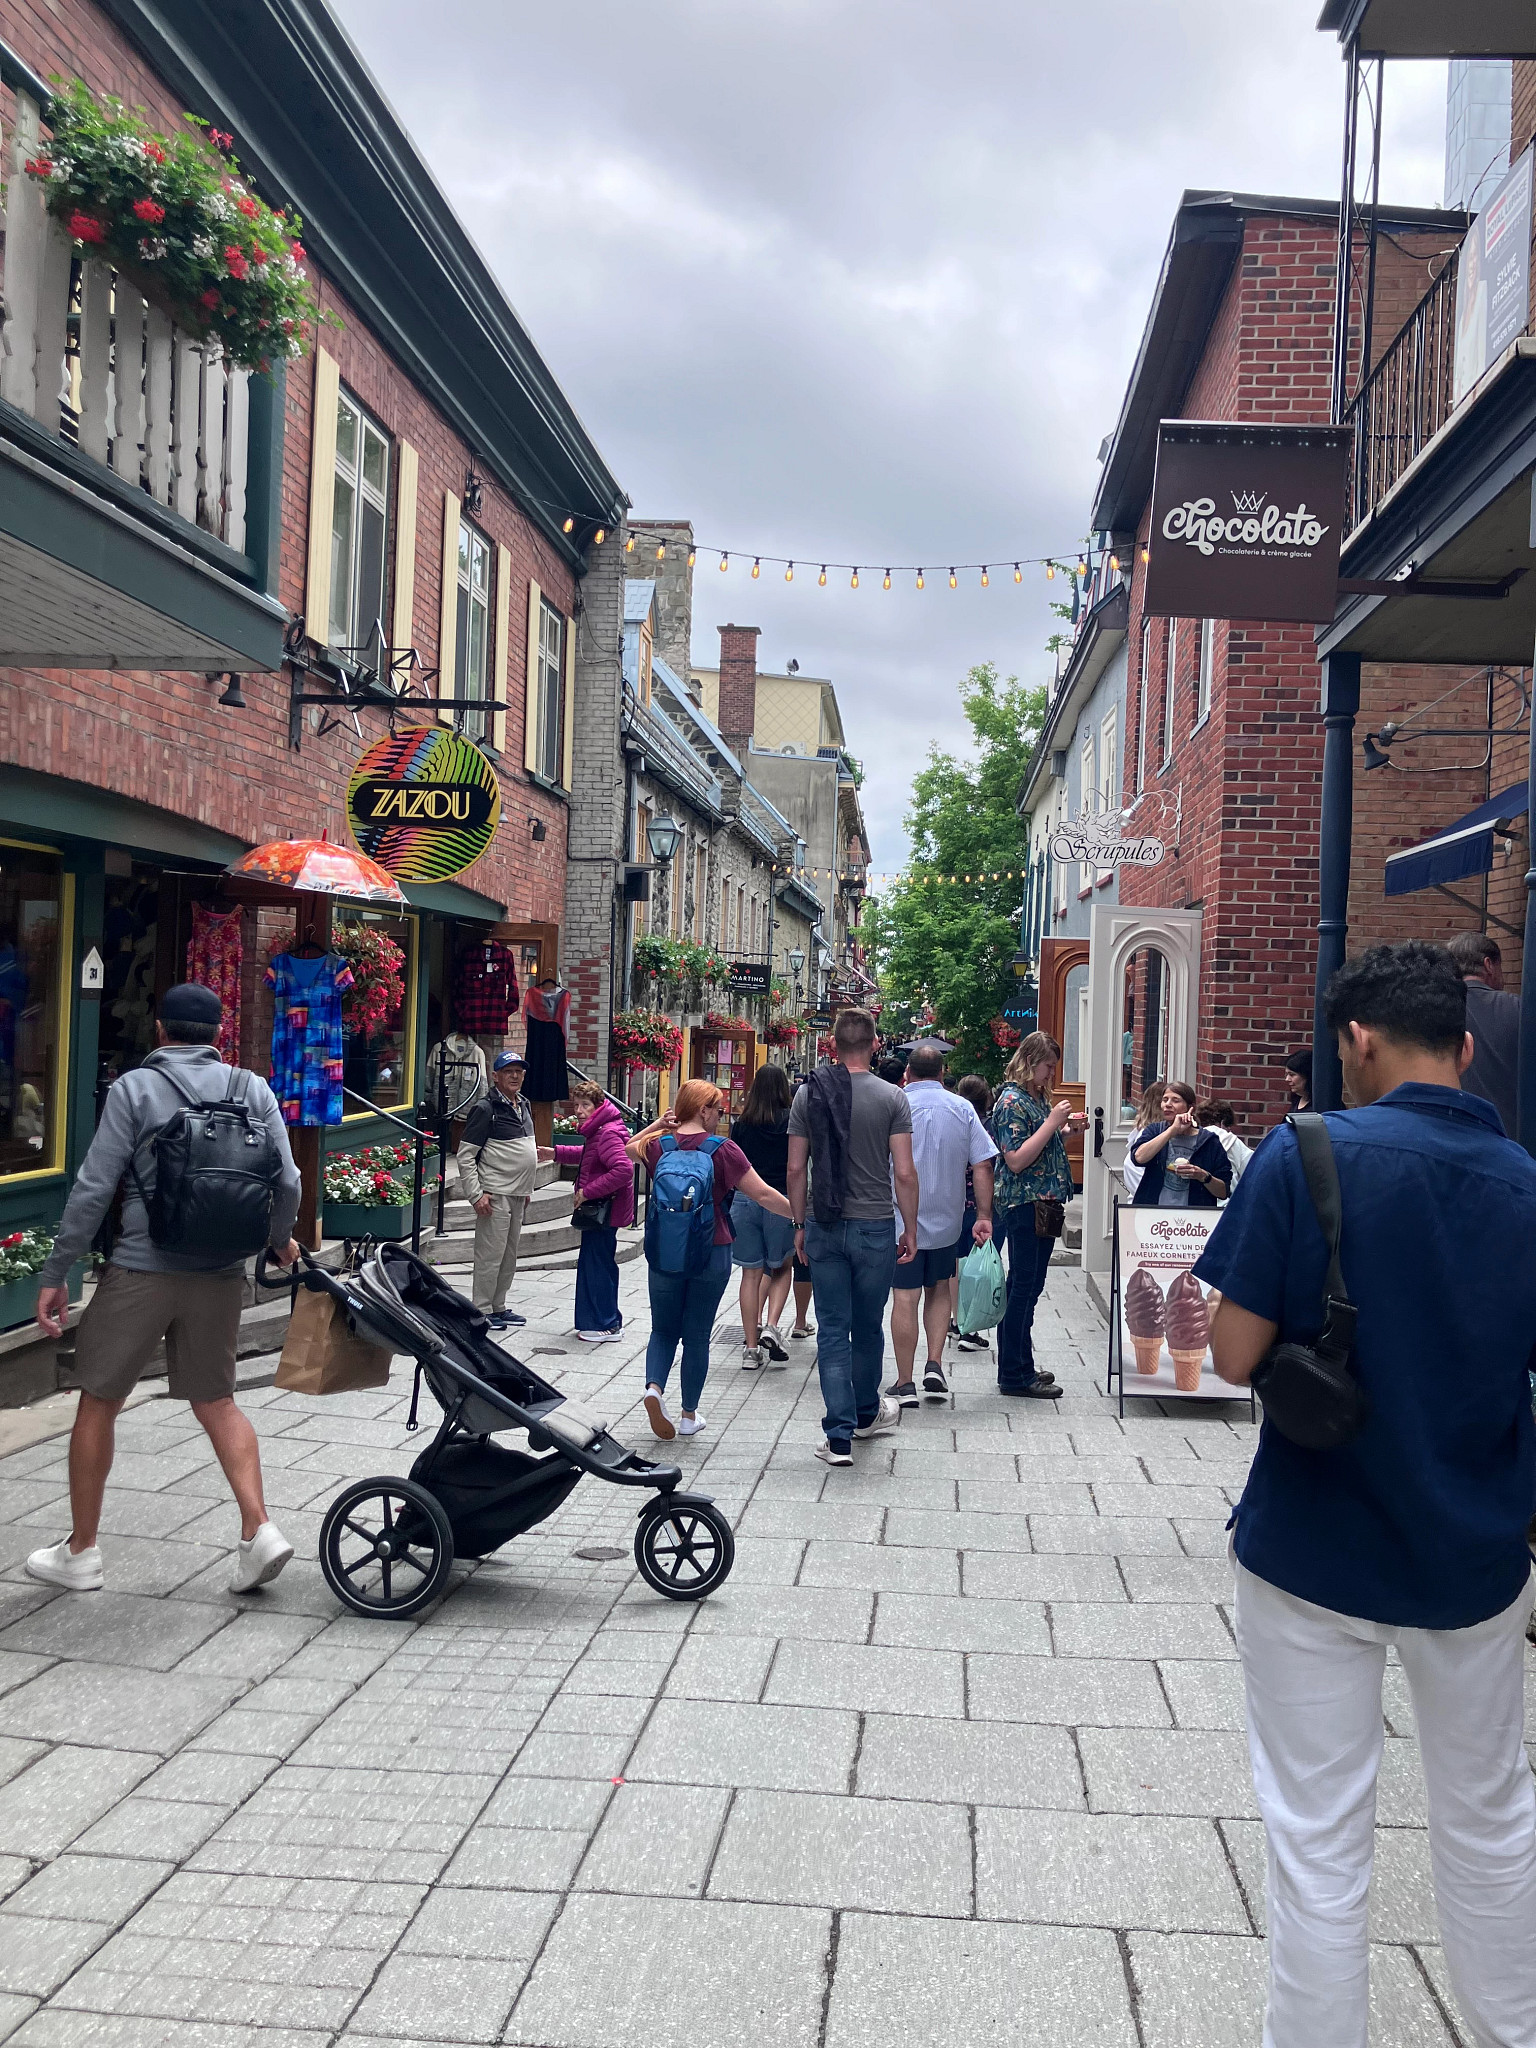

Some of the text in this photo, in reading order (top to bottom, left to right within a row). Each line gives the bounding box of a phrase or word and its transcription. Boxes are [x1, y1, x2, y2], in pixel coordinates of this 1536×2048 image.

[1497, 252, 1517, 286] SYLVIE
[1492, 264, 1521, 310] FITZBACK
[1162, 497, 1330, 556] Chocolato
[1218, 547, 1260, 556] Chocolaterie
[1267, 549, 1289, 557] crème
[1289, 550, 1312, 559] glacée
[370, 788, 470, 820] ZAZOU
[1053, 838, 1160, 867] Scrupules
[89, 967, 98, 980] 31
[731, 975, 764, 983] MARTINO
[1150, 1220, 1210, 1241] Chocolato
[1140, 1242, 1174, 1250] ESSAYEZ
[1175, 1243, 1193, 1251] L'UN
